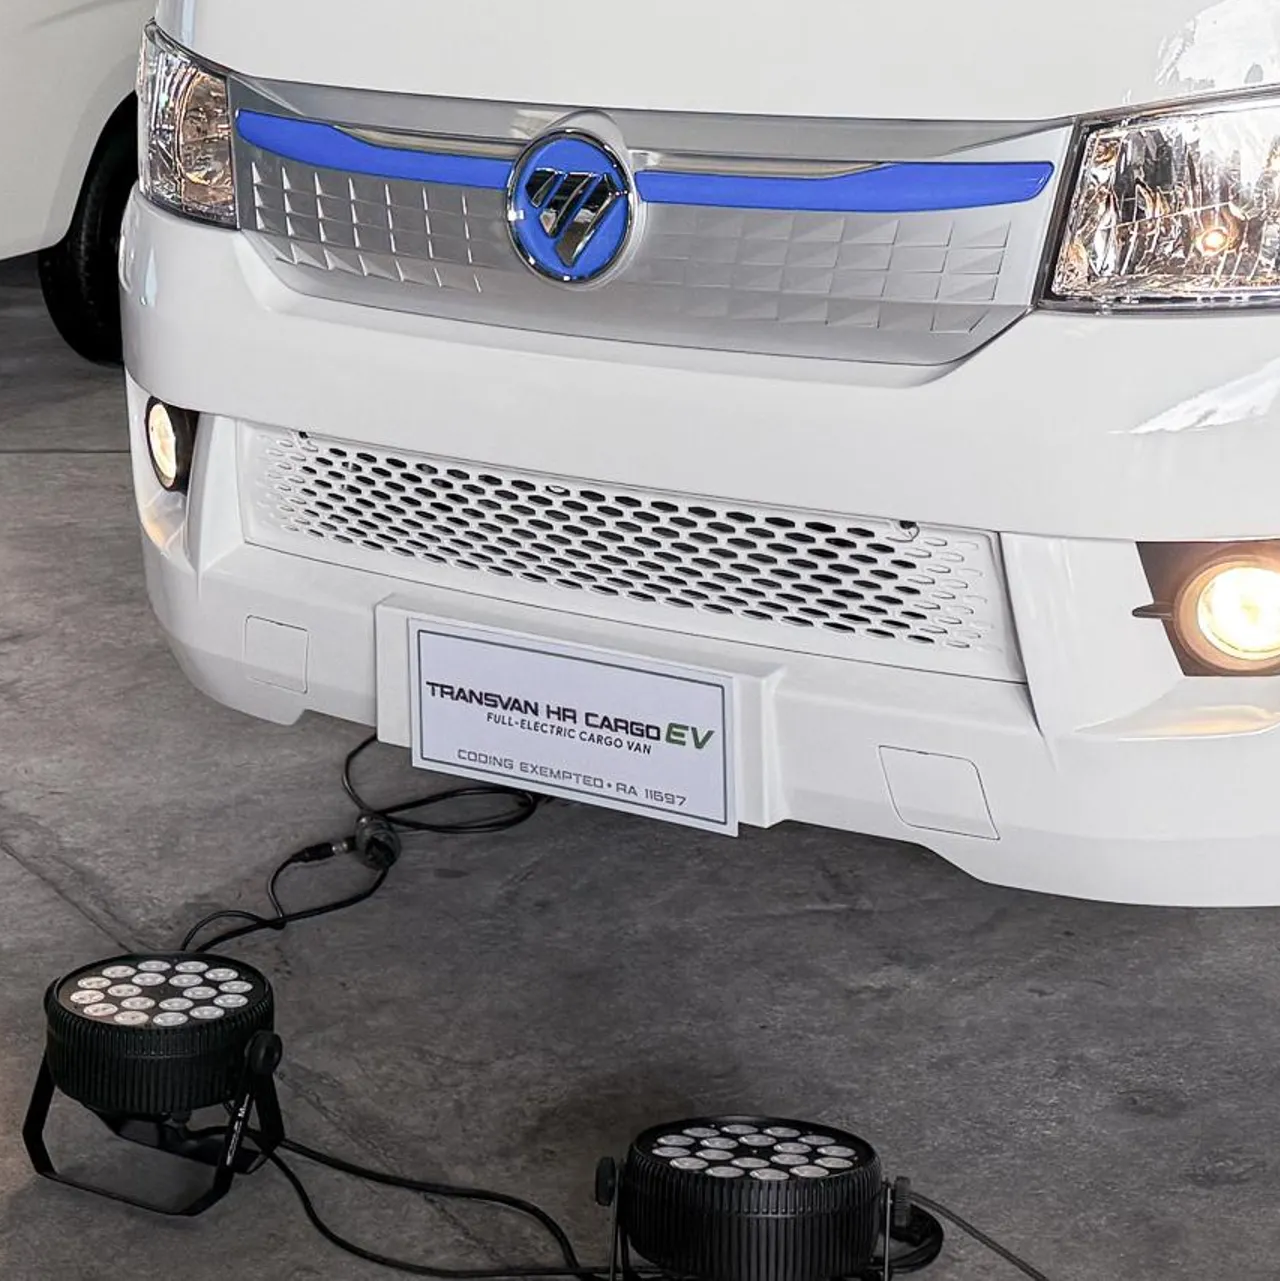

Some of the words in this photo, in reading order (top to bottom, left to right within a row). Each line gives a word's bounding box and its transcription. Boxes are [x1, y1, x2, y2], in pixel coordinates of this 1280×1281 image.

[426, 681, 540, 717] TRANSVAN
[546, 704, 577, 724] HR
[585, 712, 662, 742] CARGO
[666, 722, 715, 750] EV
[486, 711, 576, 740] FULL-ELECTRIC
[578, 730, 624, 749] CARGO
[627, 741, 652, 755] VAN
[457, 748, 514, 771] CODING
[519, 761, 604, 789] EXEMPTED
[616, 782, 638, 797] RA
[644, 787, 687, 807] 11697
